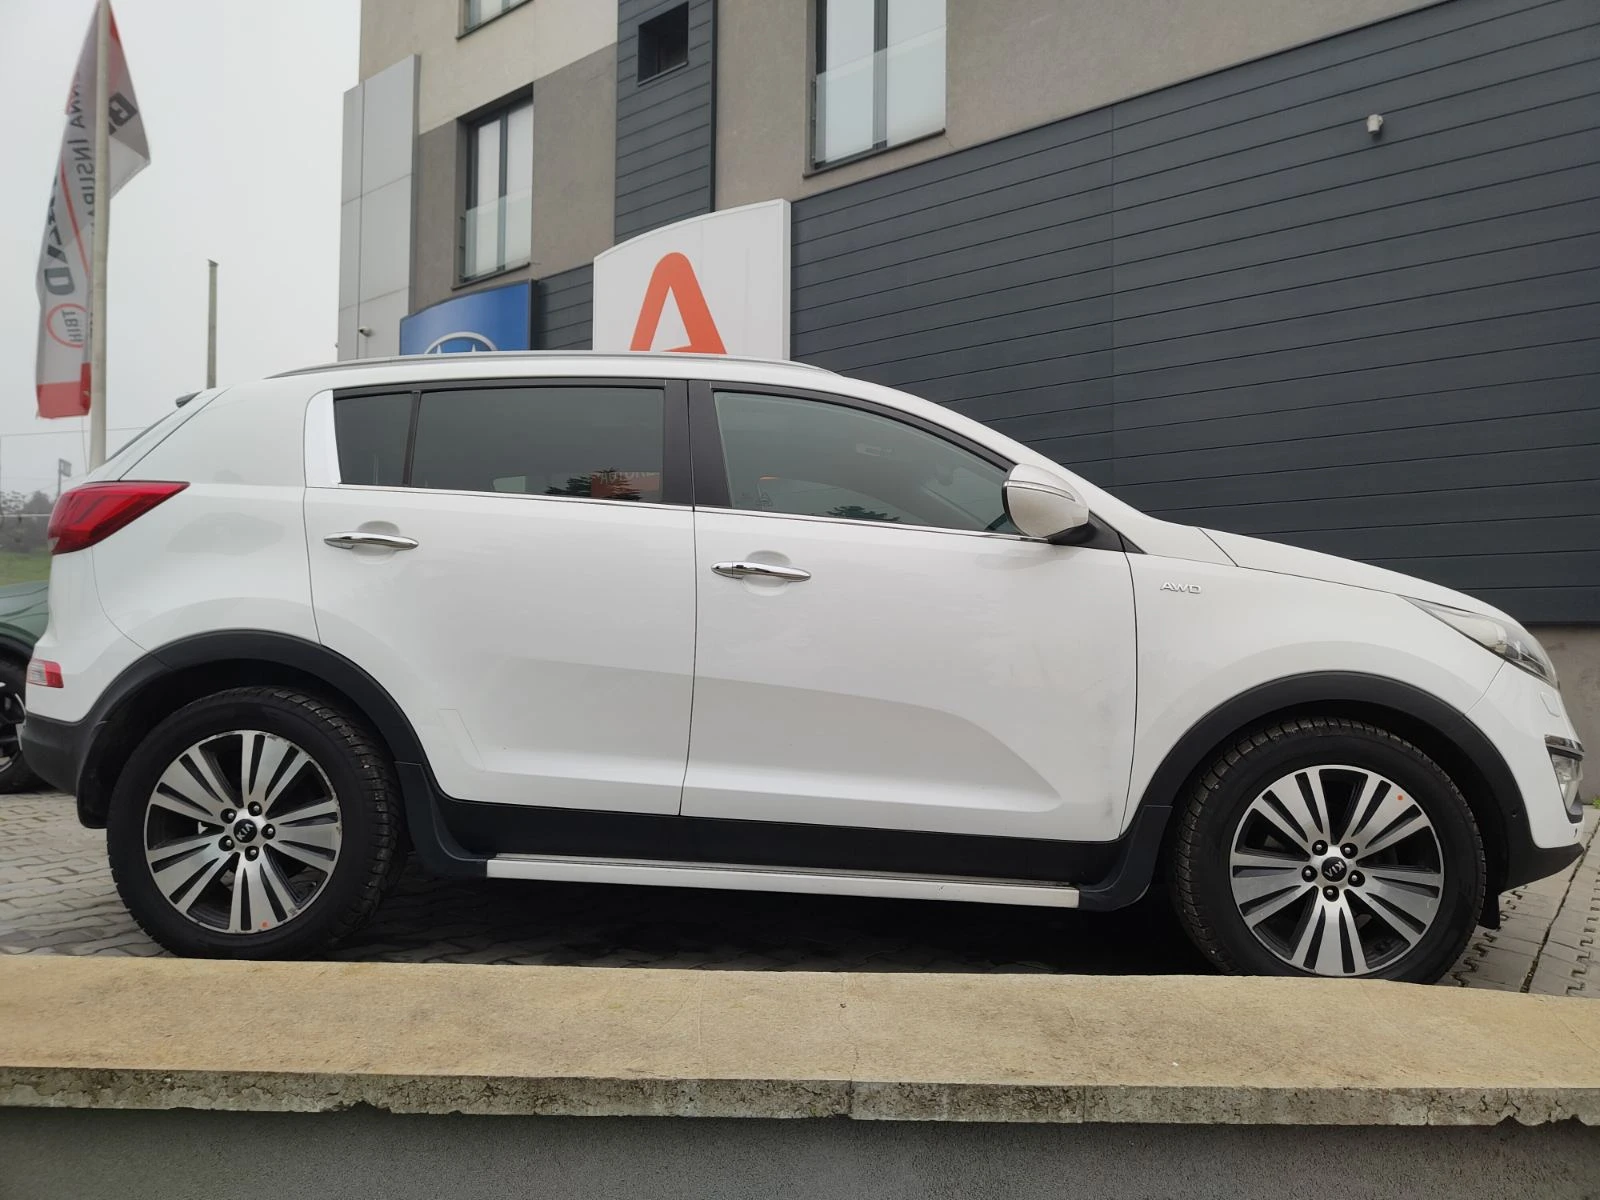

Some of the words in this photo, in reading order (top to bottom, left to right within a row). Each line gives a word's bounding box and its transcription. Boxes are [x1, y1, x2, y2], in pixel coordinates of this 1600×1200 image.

[1160, 581, 1202, 595] AWD
[236, 823, 254, 841] KIA
[1324, 861, 1345, 877] KIA
